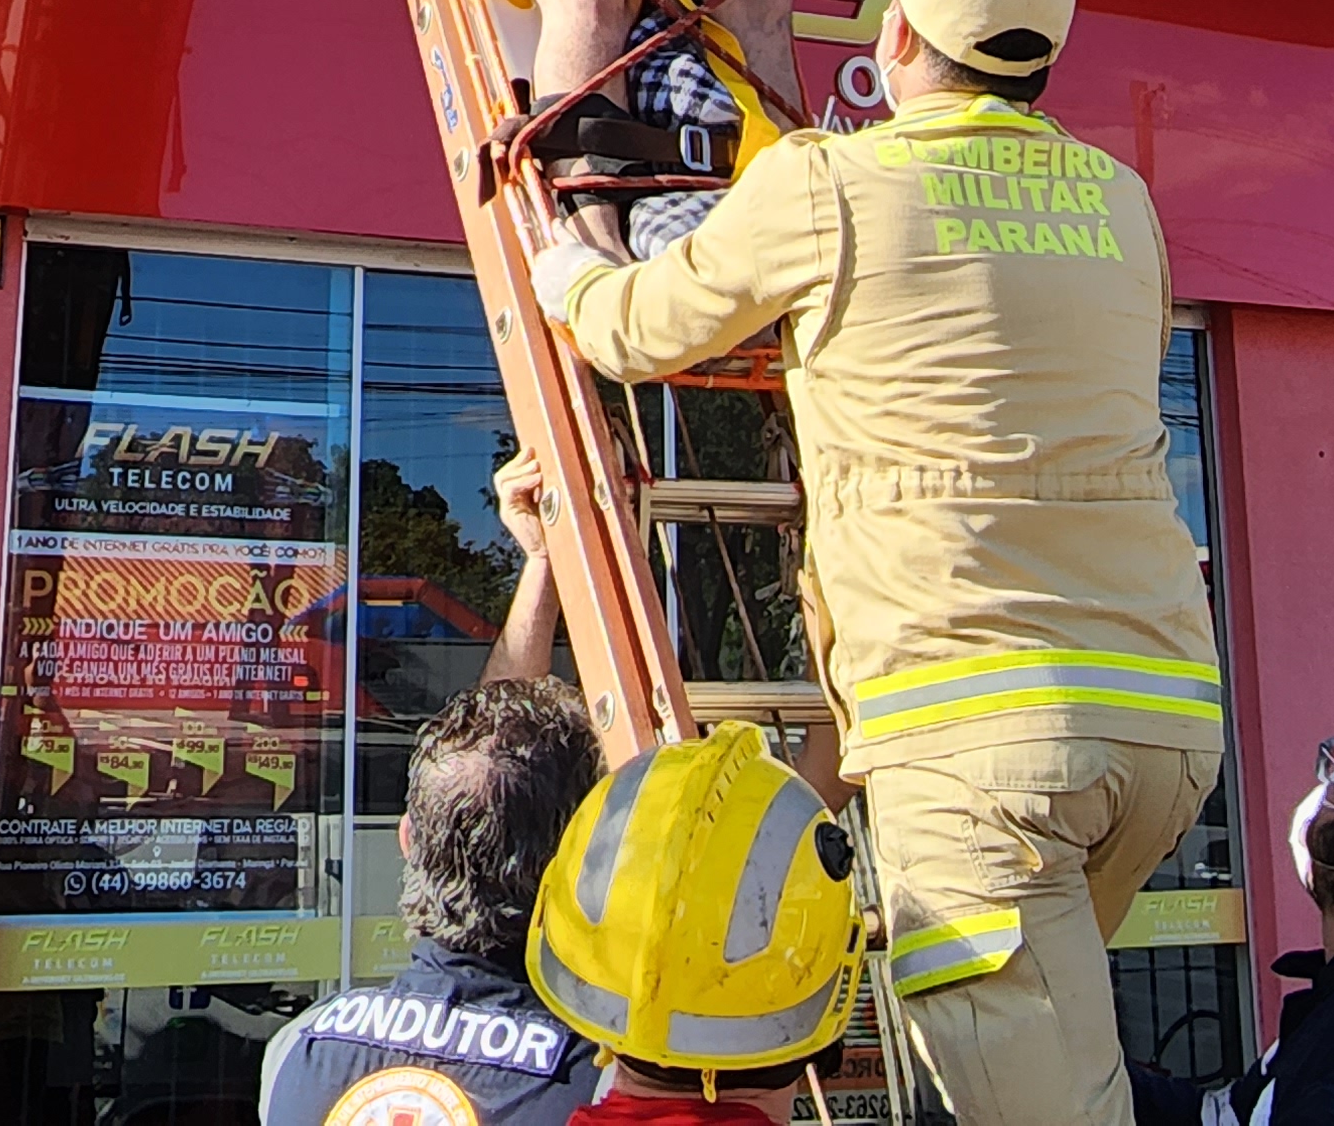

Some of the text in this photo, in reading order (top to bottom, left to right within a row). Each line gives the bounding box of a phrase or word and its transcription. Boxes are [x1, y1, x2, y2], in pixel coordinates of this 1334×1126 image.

[874, 137, 1115, 182] BOMBEIRO
[923, 174, 1111, 216] MILITAR
[934, 218, 1124, 262] PARANÁ
[75, 422, 279, 468] FLASH
[108, 467, 233, 493] TELECOM
[54, 497, 292, 521] ULTRA VELOCIDADE E ESTABILIDADE
[17, 534, 23, 549] 1
[24, 535, 58, 550] ANO
[61, 536, 81, 551] DE
[83, 538, 147, 553] INTERNET
[151, 539, 199, 555] GRÁTIS
[22, 568, 309, 620] PROMOÇÃO
[59, 618, 274, 644] INDIQUE UM AMIGO
[18, 640, 307, 665] A CADA AMIGO QUE ADERIR A UM PLANO MENSAL
[36, 659, 70, 677] VOCÊ
[72, 660, 116, 678] GANHA
[118, 661, 139, 679] UM
[169, 660, 211, 680] GRÁTIS
[213, 663, 230, 680] DE
[79, 819, 92, 835] A
[94, 819, 159, 836] MELHOR
[160, 819, 230, 835] INTERNET
[232, 819, 252, 834] DA
[90, 869, 247, 896] (44) 99860-3674
[1144, 895, 1217, 916] FLASH
[22, 928, 130, 953] FLASH
[200, 925, 302, 948] FLASH
[33, 956, 114, 972] TELECOM
[314, 994, 559, 1070] CONDUTOR
